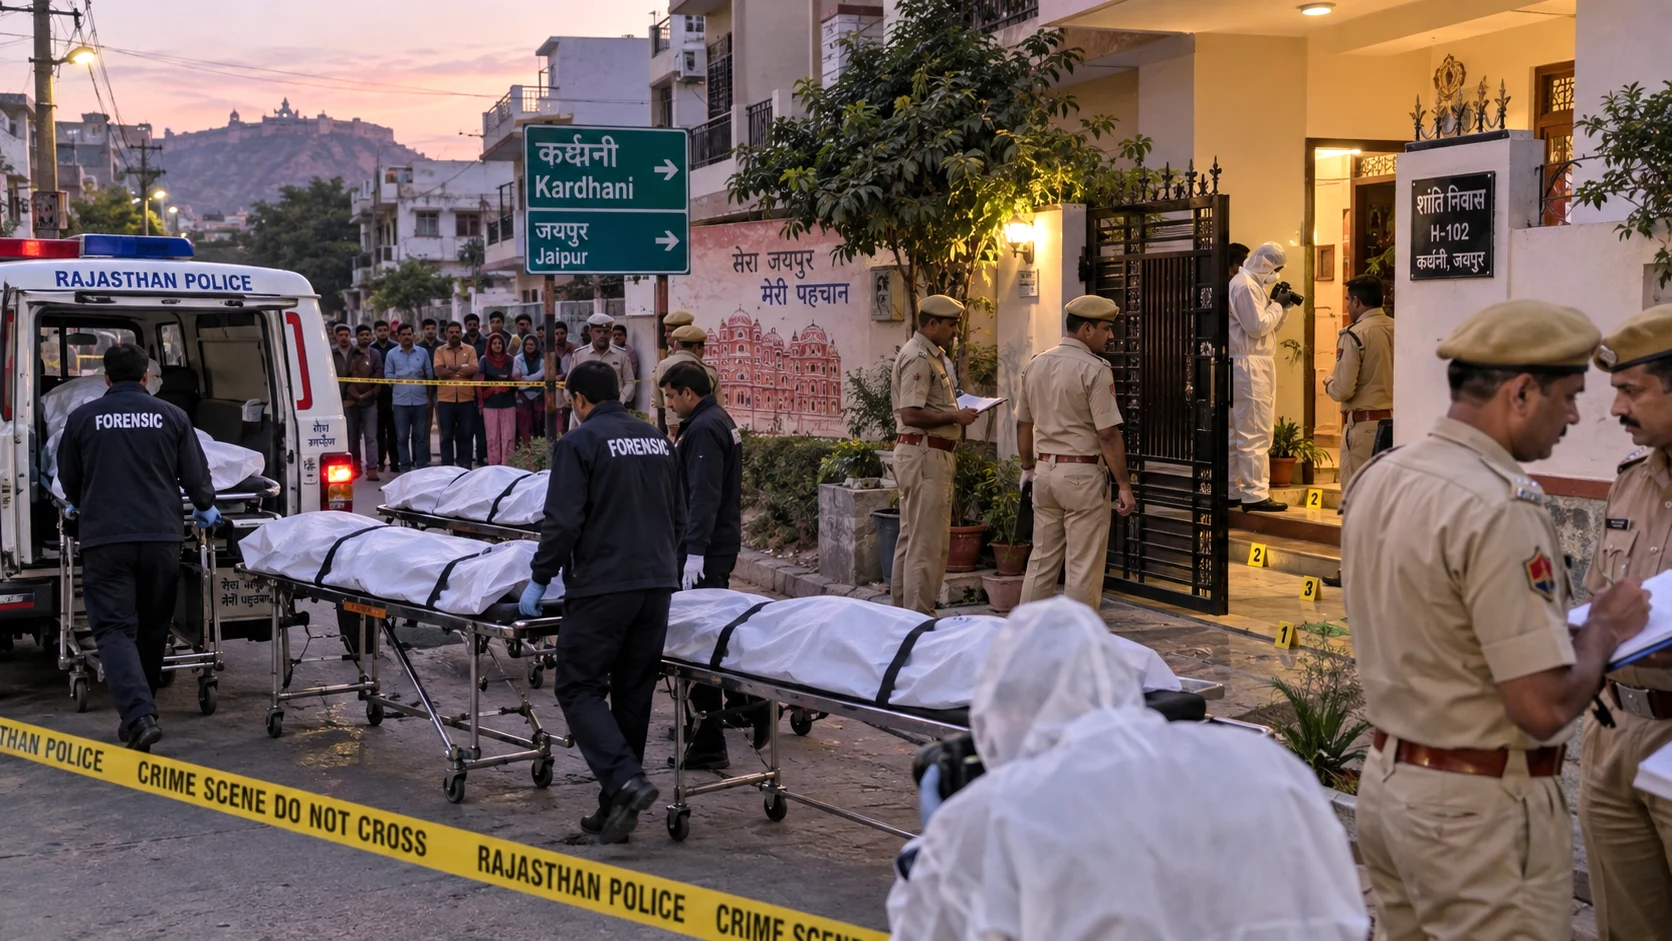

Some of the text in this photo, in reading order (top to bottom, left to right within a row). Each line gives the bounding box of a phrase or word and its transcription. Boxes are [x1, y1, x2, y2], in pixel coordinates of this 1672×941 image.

[535, 175, 634, 200] Kardhani
[1416, 184, 1487, 215] शांति निवास
[535, 222, 590, 248] जयपुर
[1430, 222, 1470, 242] H-102
[535, 247, 589, 269] Jaipur
[732, 245, 815, 280] मेरा जयपुर
[54, 270, 254, 292] RAJASTHAN POLICE
[760, 277, 850, 308] मेरी पहचान
[95, 412, 163, 431] FORENSIC
[607, 438, 670, 458] FORENSIC
[1310, 492, 1319, 506] 2
[1253, 547, 1261, 562] 2
[1304, 580, 1313, 597] 3
[1281, 625, 1288, 644] 1
[45, 737, 105, 773] POLICE
[138, 760, 197, 797] CRIME
[203, 776, 267, 815] SCENE
[274, 794, 301, 824] DO
[309, 803, 351, 836] NOT
[358, 815, 427, 857] CROSS
[477, 845, 601, 902] RAJASTHAN
[609, 877, 686, 924] POLICE
[716, 903, 785, 941] CRIME
